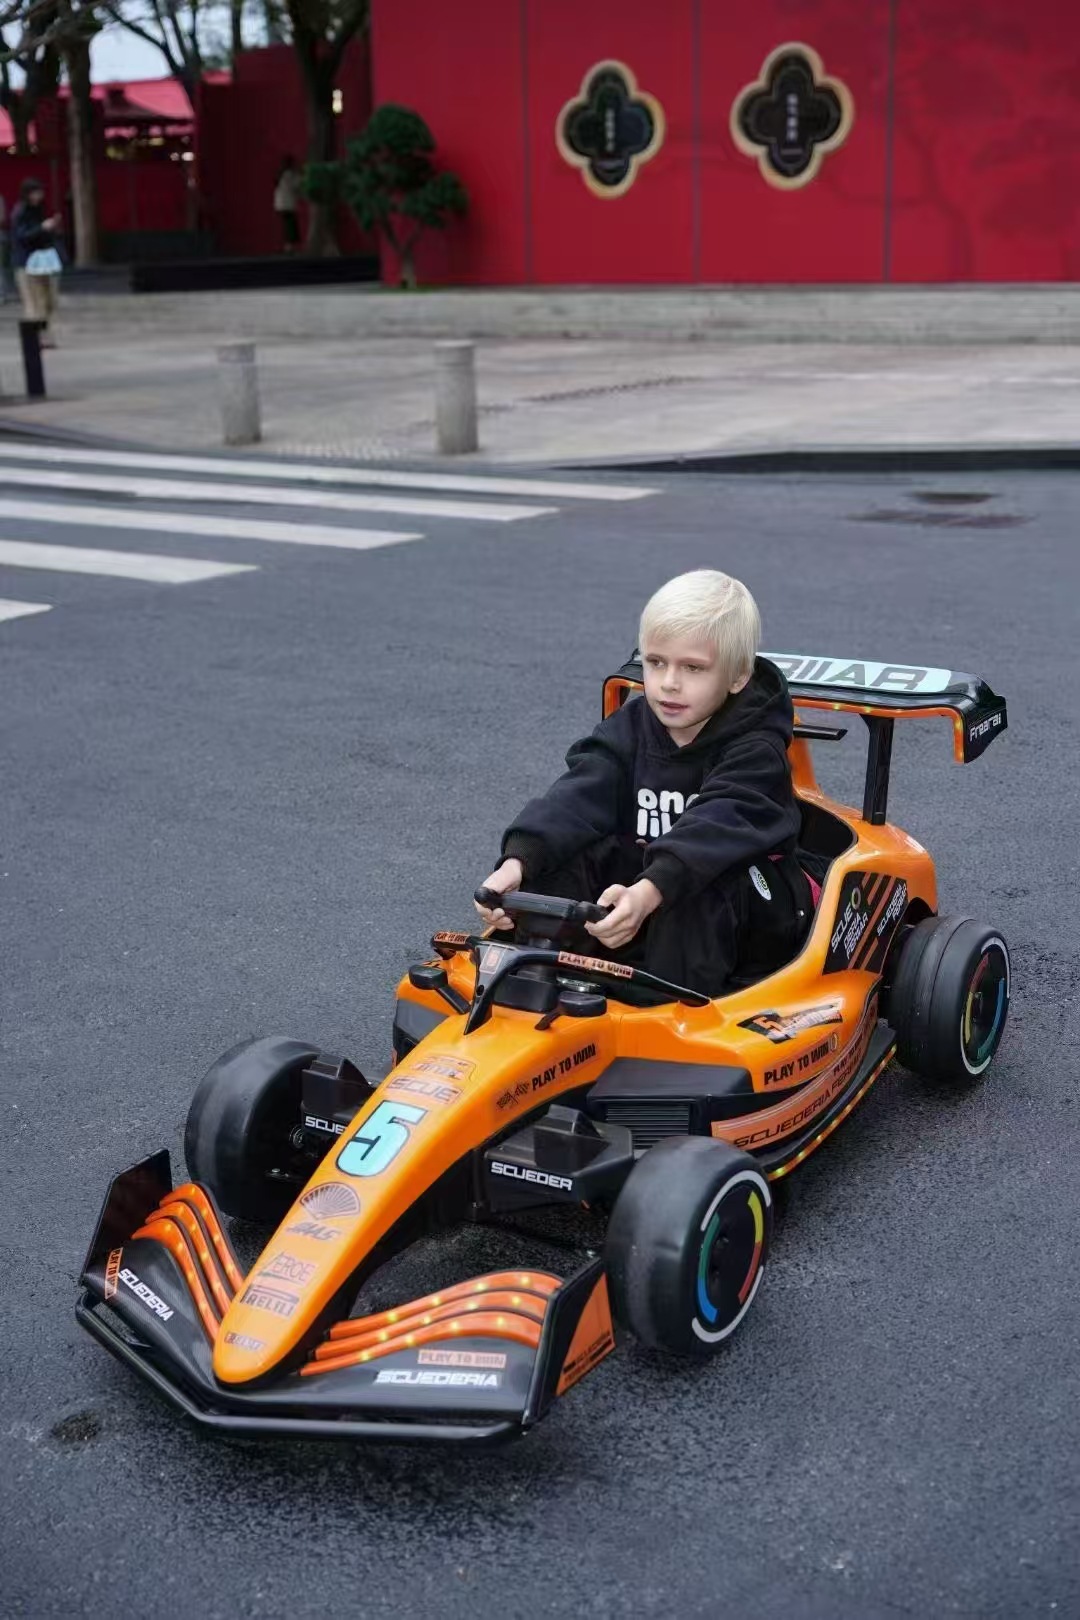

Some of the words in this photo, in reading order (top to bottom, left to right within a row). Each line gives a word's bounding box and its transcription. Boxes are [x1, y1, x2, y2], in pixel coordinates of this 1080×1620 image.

[559, 953, 587, 965] PLAY
[591, 959, 605, 969] TO
[532, 1065, 557, 1091] PLAY
[558, 1057, 572, 1075] TO
[572, 1043, 596, 1067] WIN
[764, 1062, 795, 1086] PLAY
[798, 1054, 810, 1072] TO
[810, 1041, 829, 1064] WIN
[387, 1078, 460, 1103] SCUE
[733, 1090, 830, 1148] SCUEDERIA
[335, 1099, 428, 1177] 5
[490, 1161, 573, 1191] SCUEDER
[117, 1268, 175, 1321] SCUEDERIA
[421, 1352, 451, 1363] PLAY
[455, 1353, 473, 1363] TO
[374, 1369, 499, 1387] SCUEDERIA
